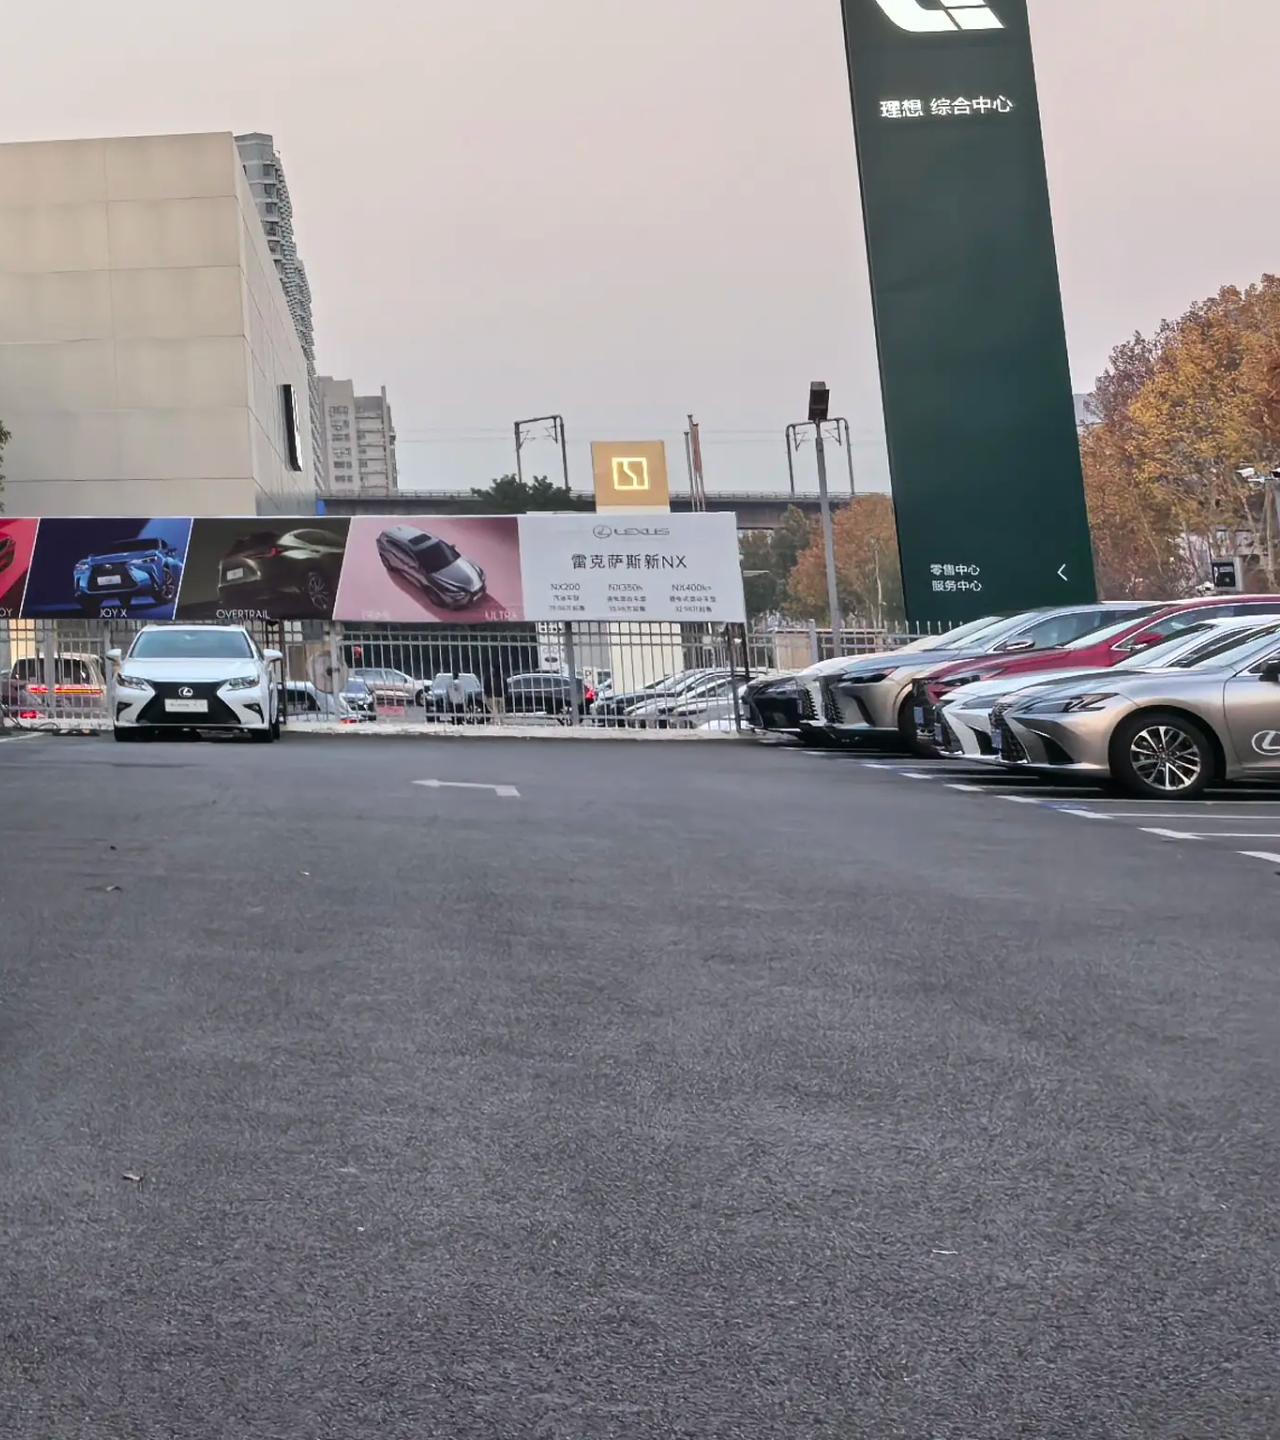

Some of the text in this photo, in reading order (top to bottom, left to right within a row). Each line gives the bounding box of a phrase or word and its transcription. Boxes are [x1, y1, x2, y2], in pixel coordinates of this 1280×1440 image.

[879, 94, 1014, 119] 理想 综合中心
[571, 553, 687, 570] 雷克萨斯新NX
[99, 608, 120, 618] JOY
[215, 609, 271, 620] OVERTRAIL
